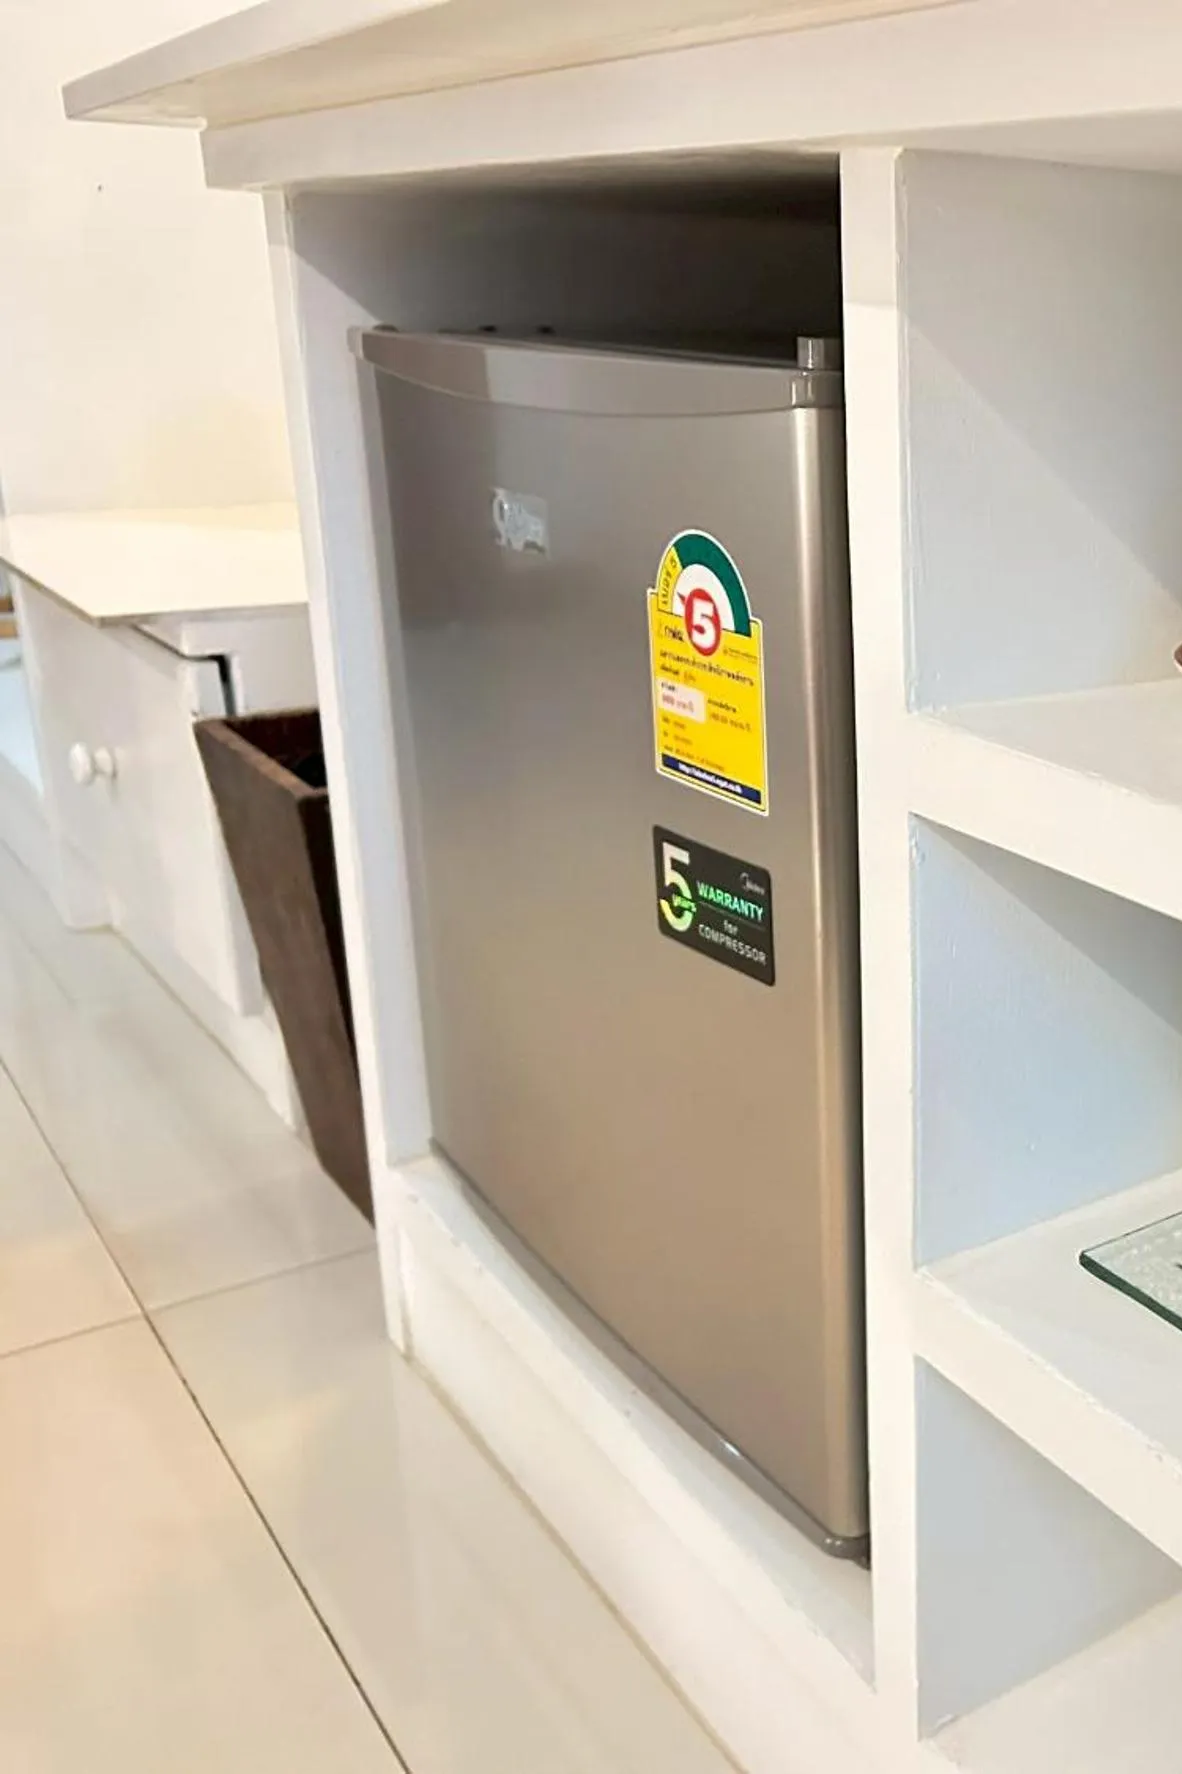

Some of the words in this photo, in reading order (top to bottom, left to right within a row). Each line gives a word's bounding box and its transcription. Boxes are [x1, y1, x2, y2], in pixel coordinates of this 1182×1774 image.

[691, 597, 716, 649] 5
[660, 841, 693, 932] 5
[696, 880, 764, 922] WARRANTY
[698, 924, 767, 966] COMPRESSOR
[723, 919, 738, 933] for
